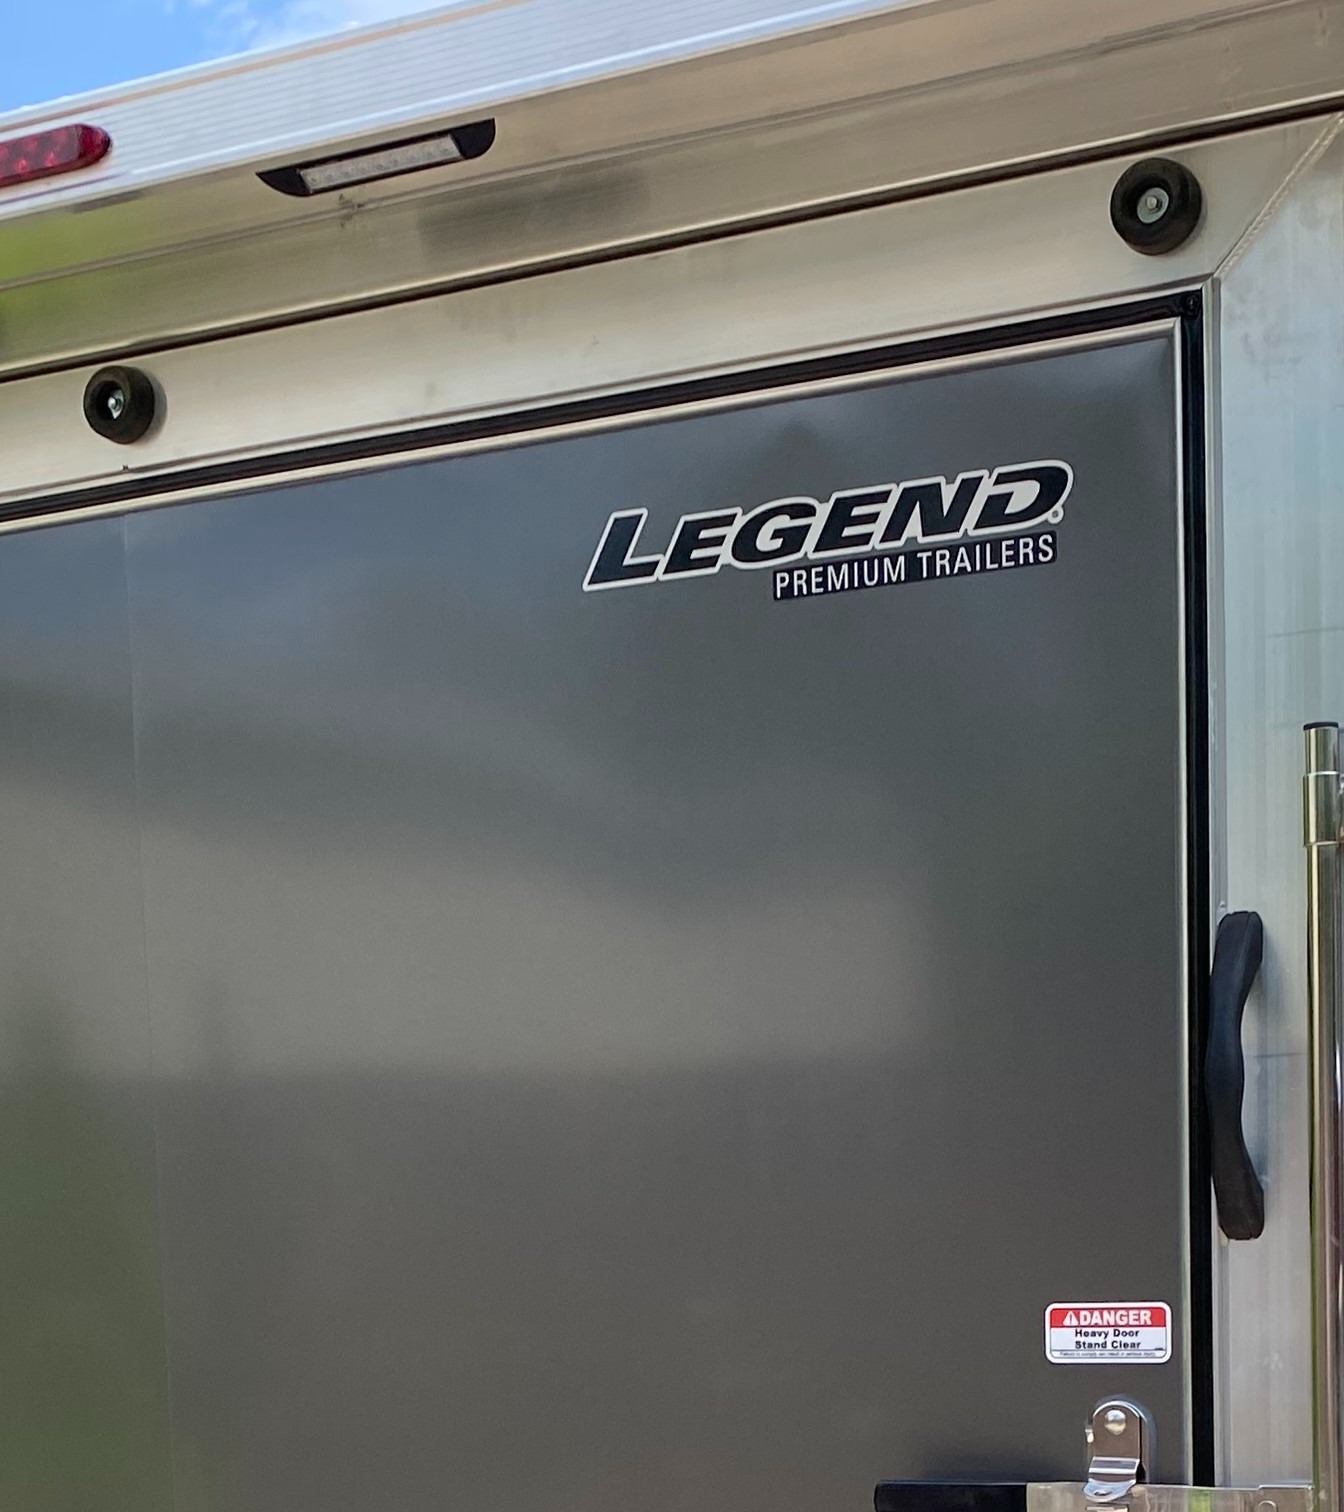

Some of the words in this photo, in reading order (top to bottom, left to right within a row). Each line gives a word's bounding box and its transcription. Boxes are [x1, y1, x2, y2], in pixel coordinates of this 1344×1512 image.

[582, 459, 1074, 592] LEGEND
[775, 556, 906, 598] PREMIUM
[917, 535, 1054, 579] TRAILERS
[1079, 1310, 1152, 1326] DANGER
[1075, 1329, 1109, 1339] Heavy
[1113, 1329, 1140, 1338] Door
[1075, 1340, 1107, 1350] Stand
[1111, 1340, 1141, 1350] Clear
